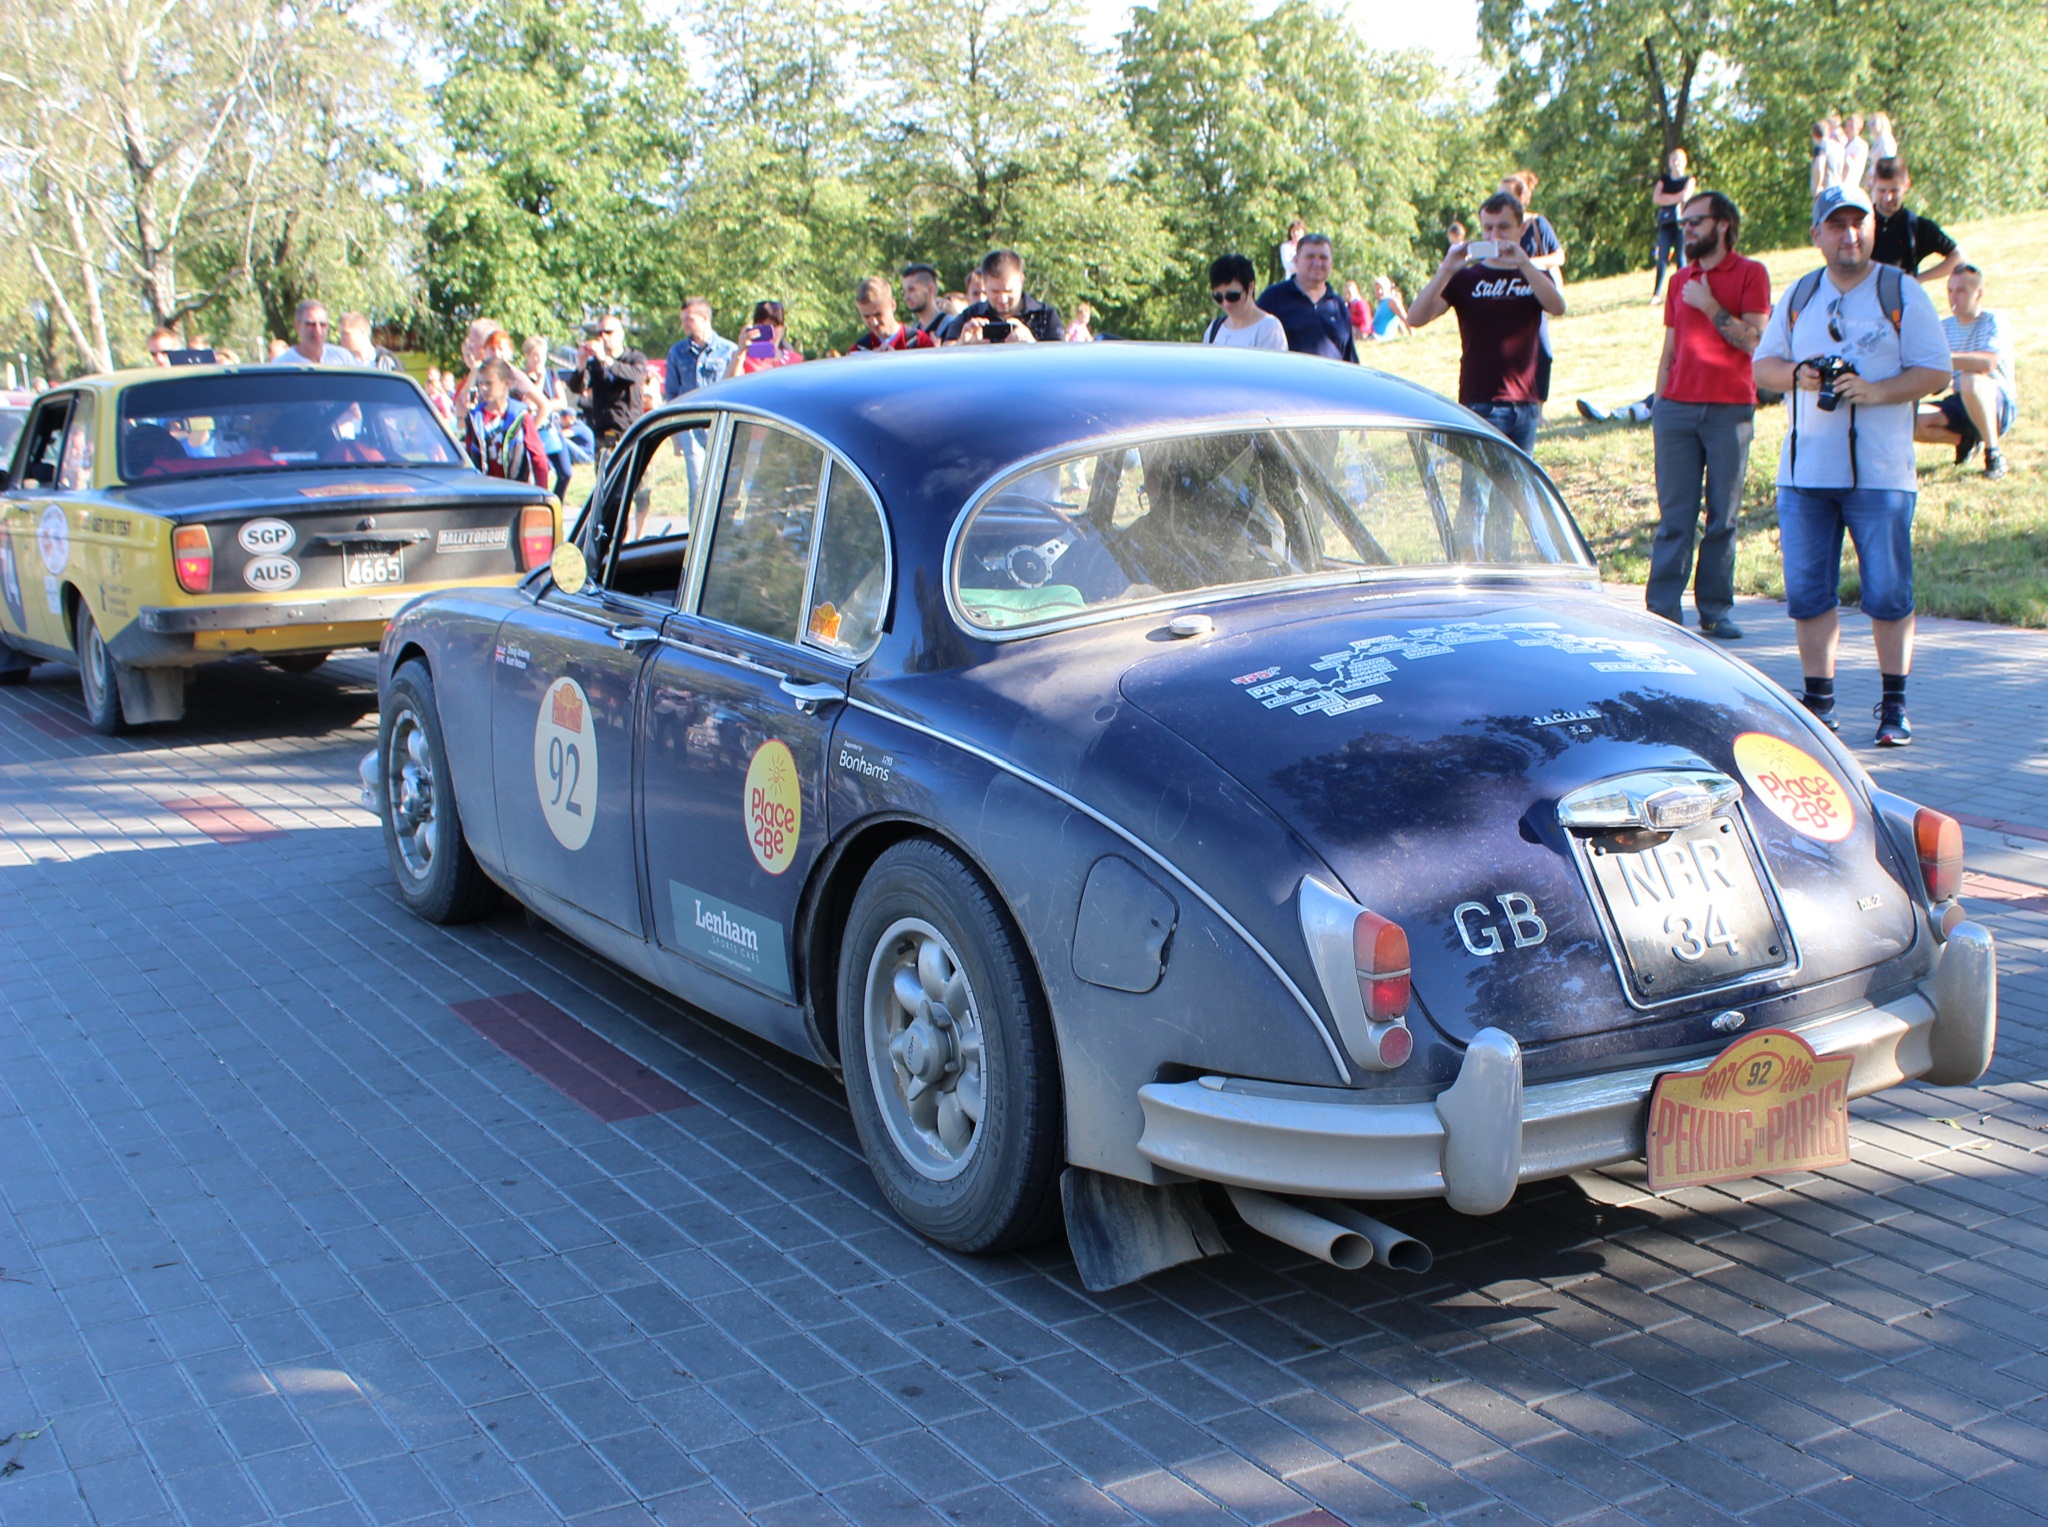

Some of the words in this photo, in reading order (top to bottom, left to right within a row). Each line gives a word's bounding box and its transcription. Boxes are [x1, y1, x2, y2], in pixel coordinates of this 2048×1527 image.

[1471, 279, 1507, 298] Still
[247, 529, 287, 545] SGP
[440, 530, 507, 545] RALLYTORQUE
[252, 565, 292, 581] AUS
[349, 557, 400, 584] 4665
[1253, 679, 1299, 696] PARIS
[1268, 691, 1306, 705] LAUSANNE
[1297, 703, 1309, 712] ST
[1533, 709, 1602, 726] JAGUAR
[549, 736, 582, 817] 92
[839, 749, 890, 782] Bonhams
[1757, 771, 1836, 800] Place
[752, 787, 795, 833] Place
[1781, 795, 1838, 828] 2Be
[754, 814, 784, 860] 2Be
[1616, 838, 1736, 907] NBR
[695, 899, 759, 952] Lenham
[1454, 892, 1548, 956] GB
[1663, 904, 1739, 964] 34
[712, 935, 738, 954] SPORTS
[741, 948, 760, 964] CARS
[1700, 1062, 1737, 1100] 1907
[1747, 1060, 1773, 1086] 92
[1780, 1055, 1814, 1094] 2016
[1657, 1097, 1753, 1177] PEKING
[1754, 1126, 1765, 1149] TO
[1768, 1079, 1843, 1162] PARIS
